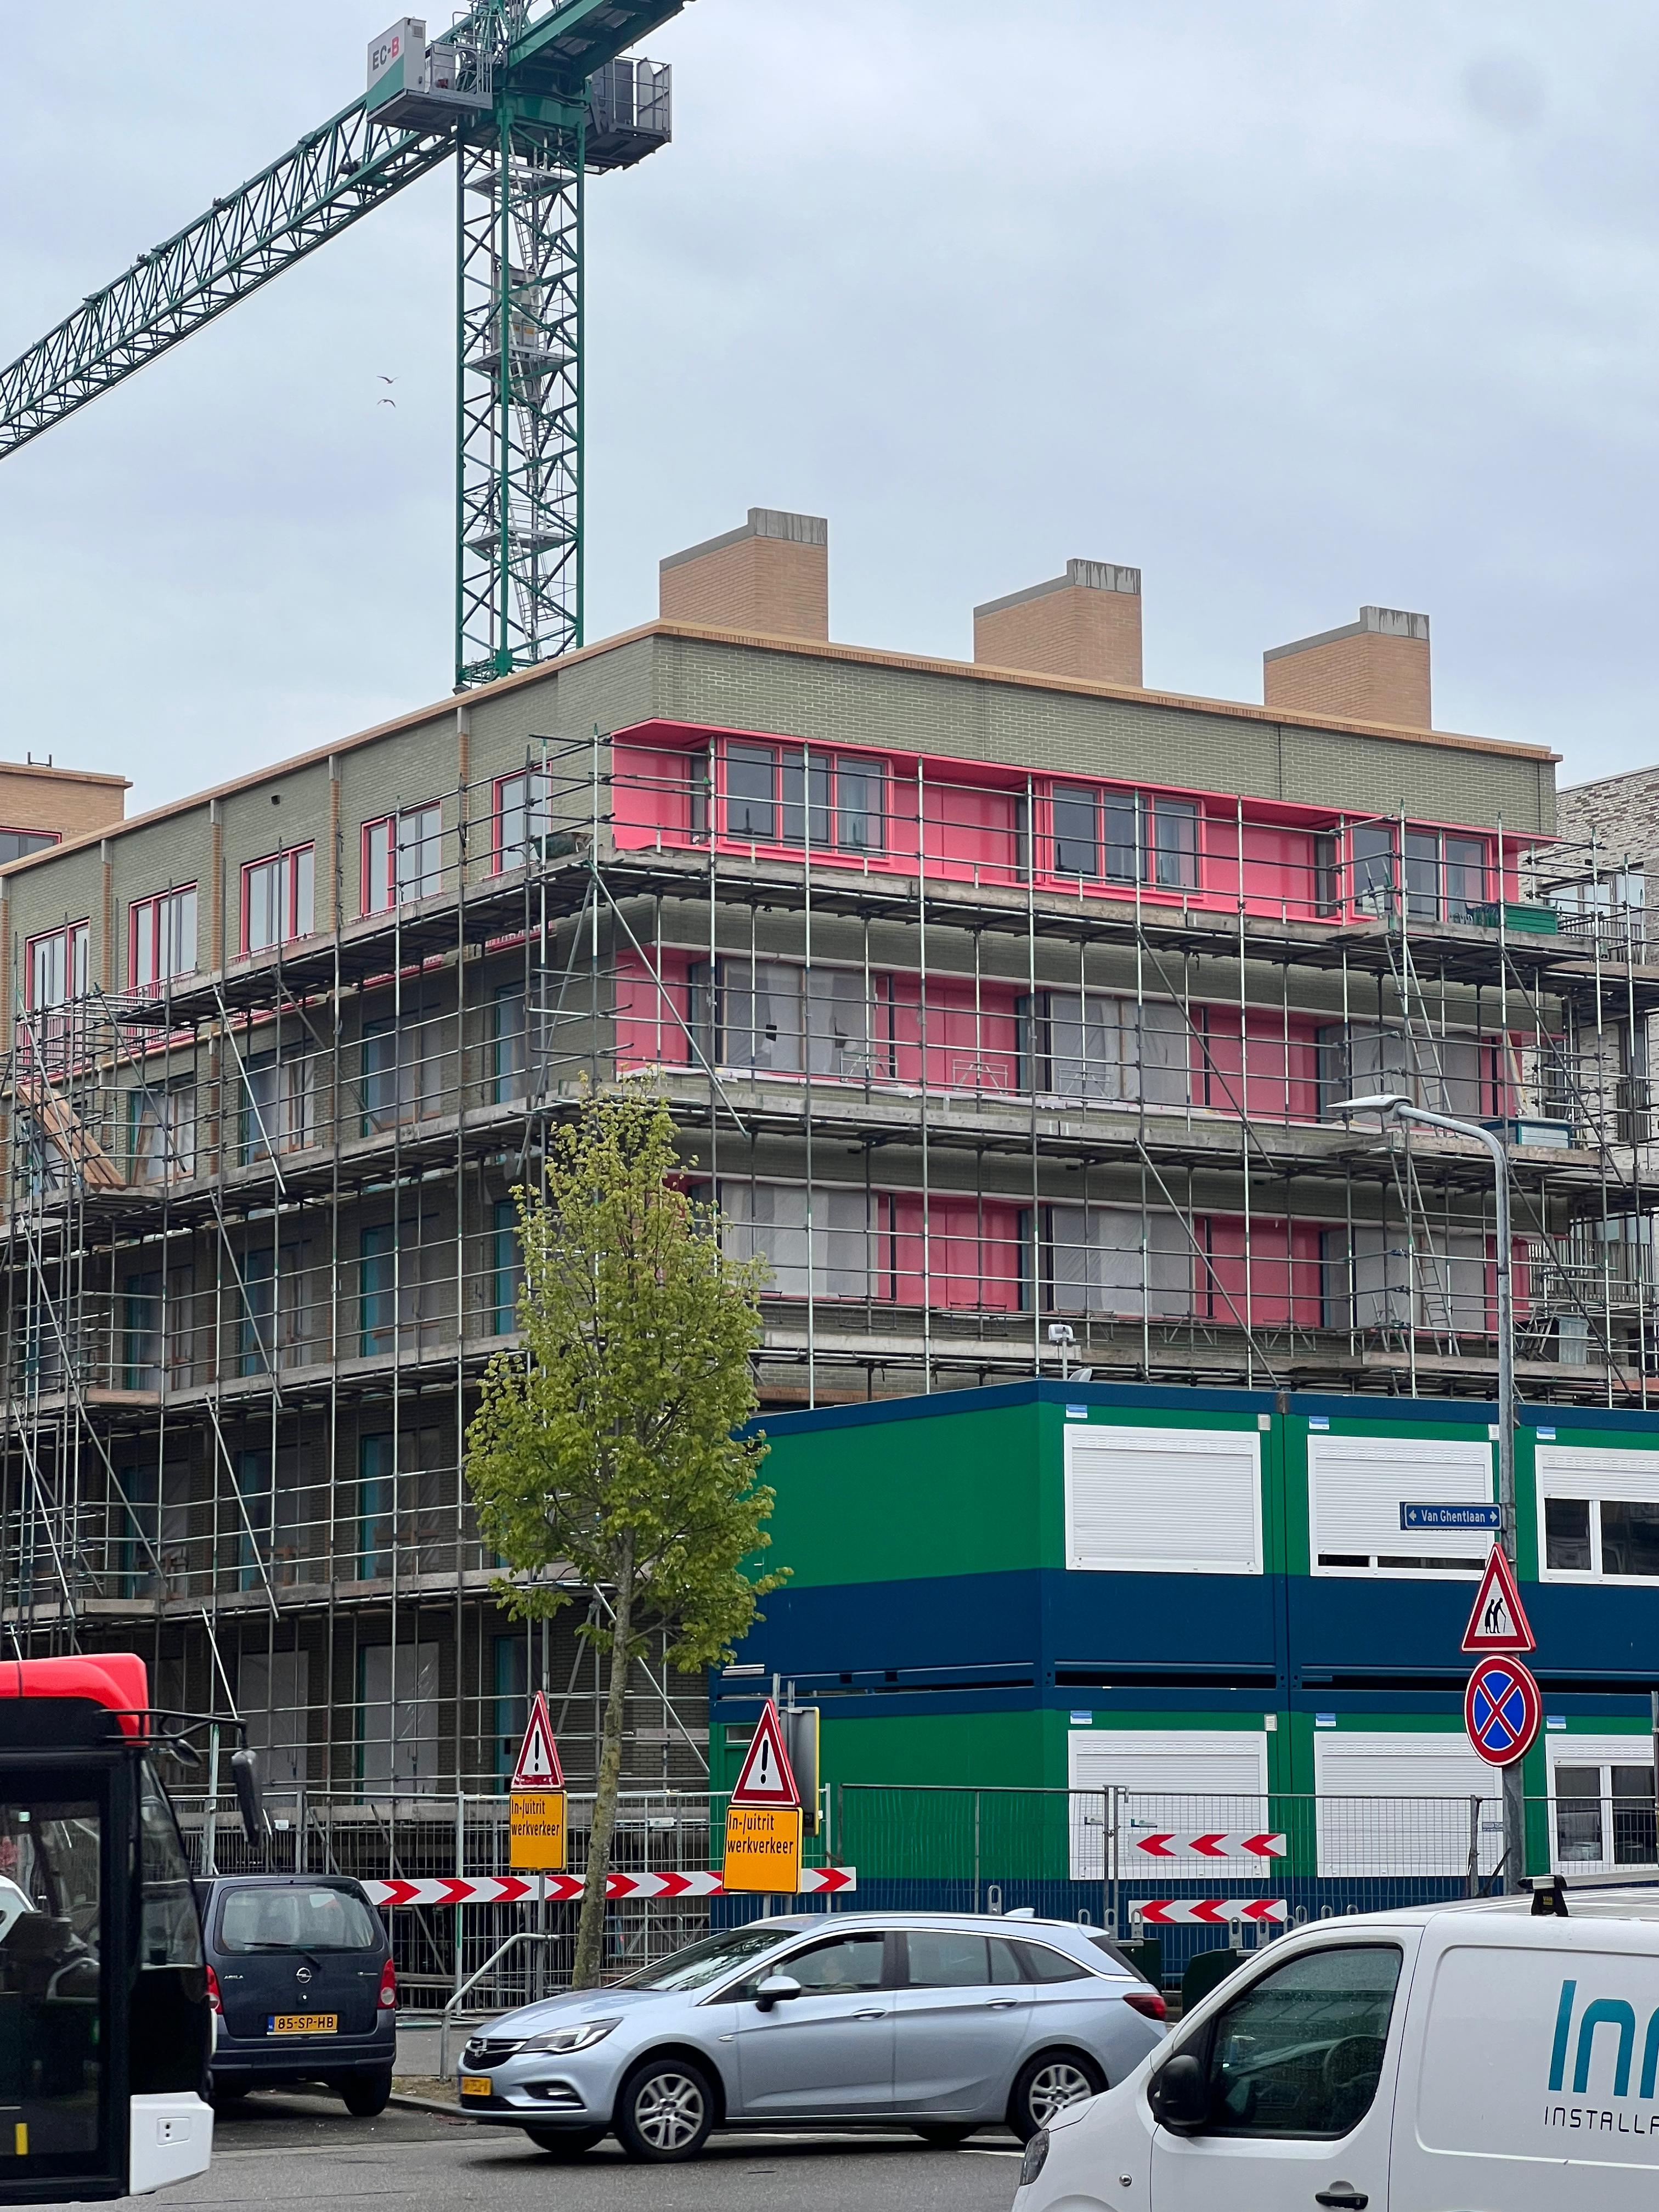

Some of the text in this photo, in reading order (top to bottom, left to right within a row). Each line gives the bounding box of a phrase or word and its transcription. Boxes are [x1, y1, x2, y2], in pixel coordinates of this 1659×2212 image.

[373, 36, 399, 70] EC-B
[1421, 1510, 1485, 1523] Van Ghentlaan
[511, 1799, 545, 1819] In-/uitrit
[511, 1820, 560, 1836] werkverkeer
[729, 1813, 774, 1835] In-/uitrit
[727, 1836, 793, 1854] werkverkeer
[278, 2017, 333, 2029] 85-SP-HB
